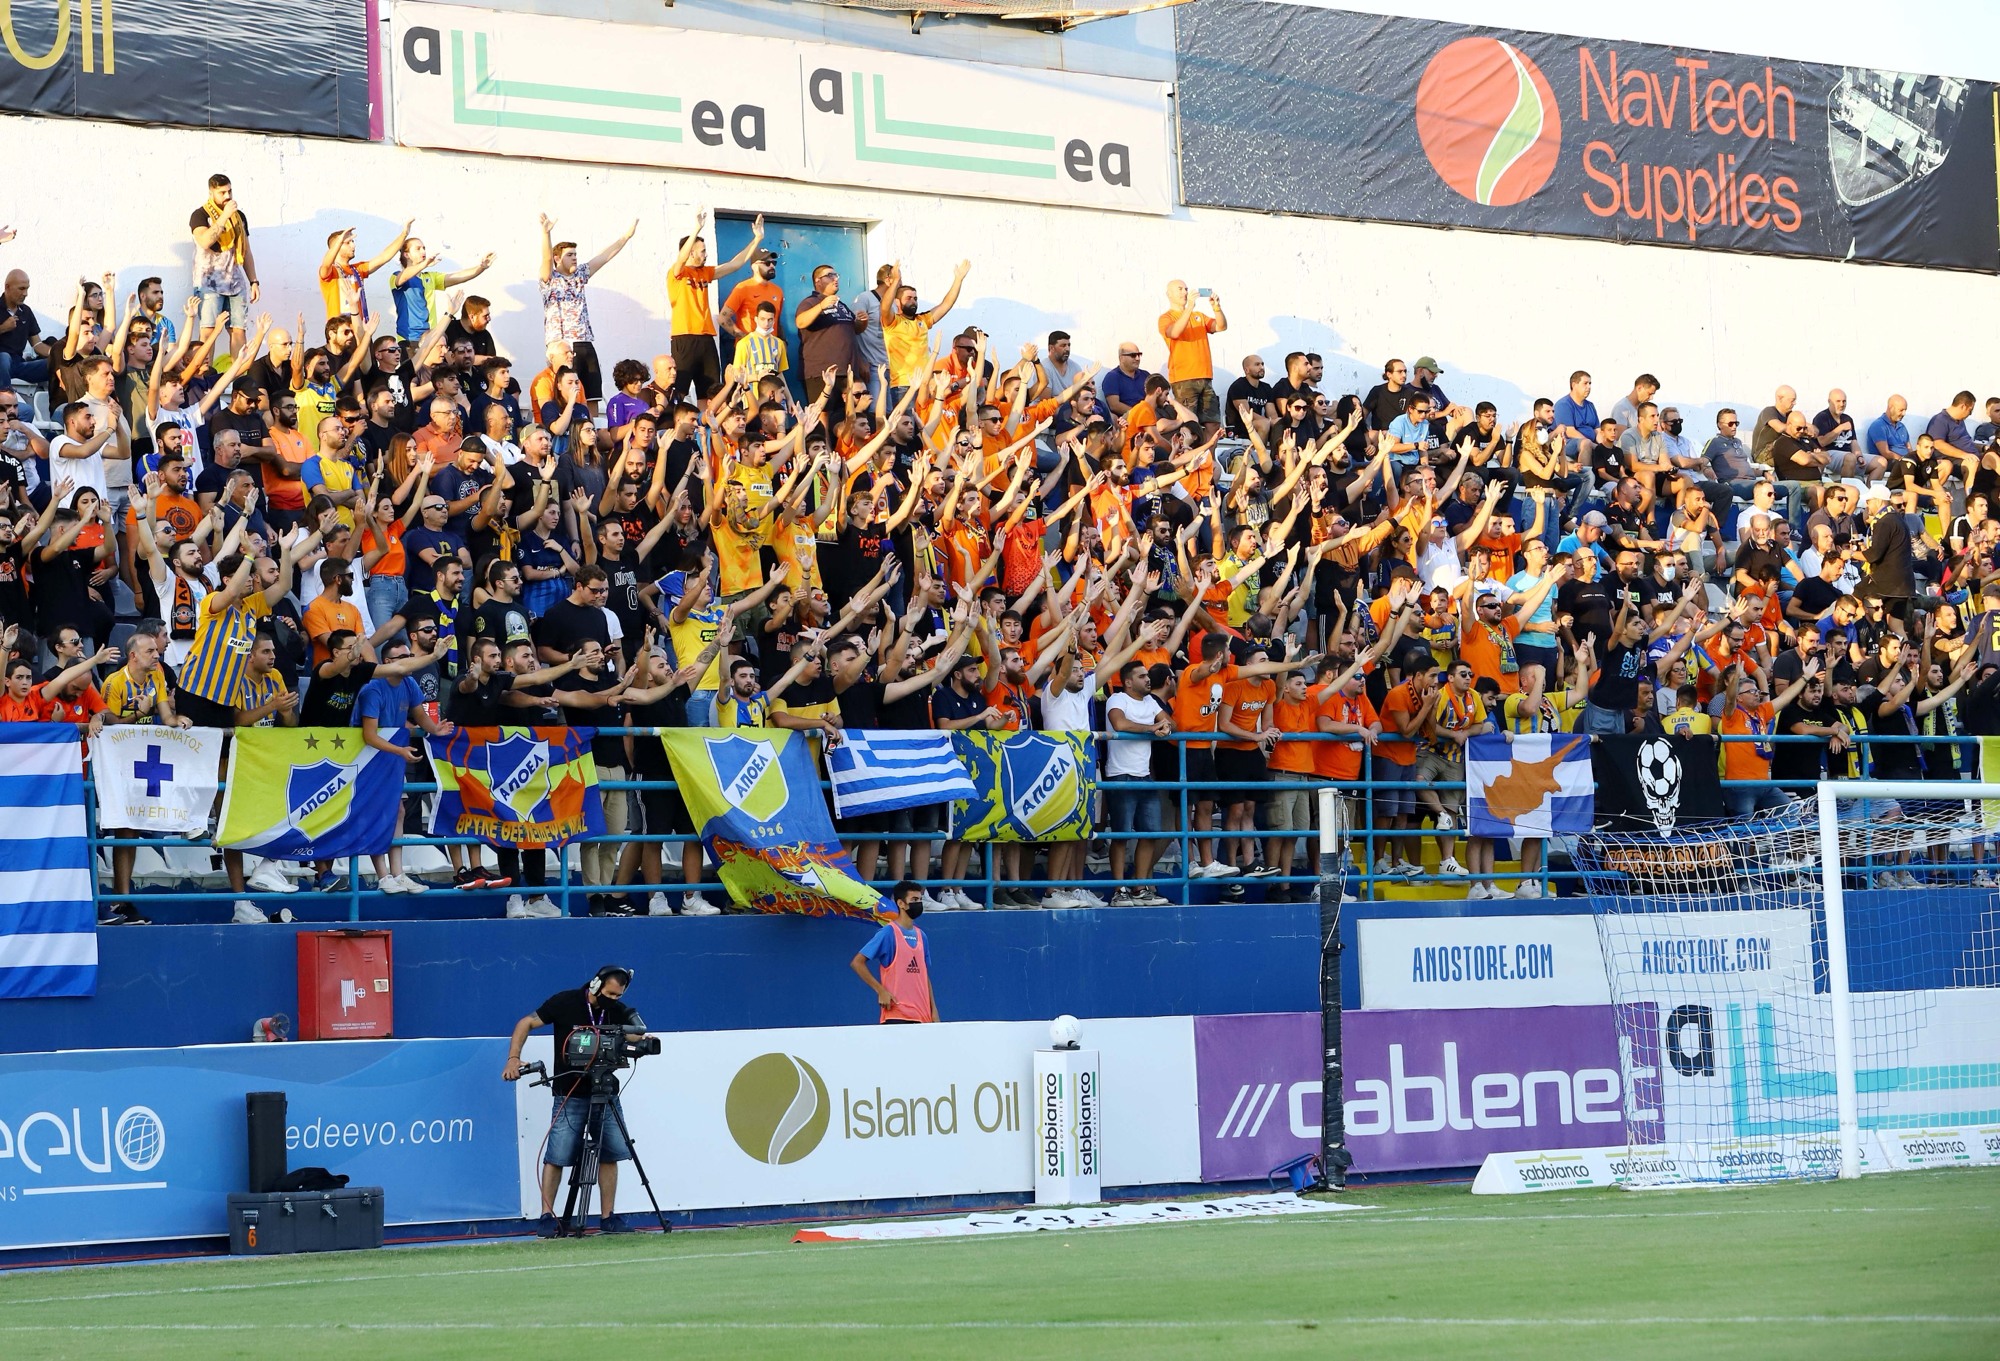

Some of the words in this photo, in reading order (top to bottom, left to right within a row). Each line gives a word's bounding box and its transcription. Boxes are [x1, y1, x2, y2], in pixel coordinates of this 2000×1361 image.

[1579, 47, 1796, 141] NavTech
[1582, 140, 1802, 241] Supplies
[111, 728, 136, 745] ΝΙΚΗ
[154, 727, 204, 754] ΘΑΝΑΤΟΣ
[499, 754, 545, 801] ΑΠΟΕΛ
[735, 754, 769, 798] ΑΠΟΕΛ
[1022, 757, 1071, 816] ΑΠΟΕΛ
[299, 777, 347, 820] ΑΠΟΕΛ
[750, 822, 784, 839] 1926
[291, 846, 315, 856] 1926
[1412, 943, 1554, 983] ANOSTORE.COM
[1642, 936, 1771, 976] ANOSTORE.COM
[843, 1083, 958, 1139] Island
[973, 1081, 1020, 1134] Oil
[1044, 1072, 1059, 1177] sabbianco
[1079, 1071, 1093, 1176] sabbianco
[285, 1116, 474, 1150] edeevo.com
[1903, 1138, 1966, 1156] sabbianco
[1519, 1162, 1590, 1181] sabbianco
[1610, 1157, 1677, 1175] sabbianco
[1716, 1149, 1784, 1167] sabbianco
[248, 1228, 257, 1248] 6
